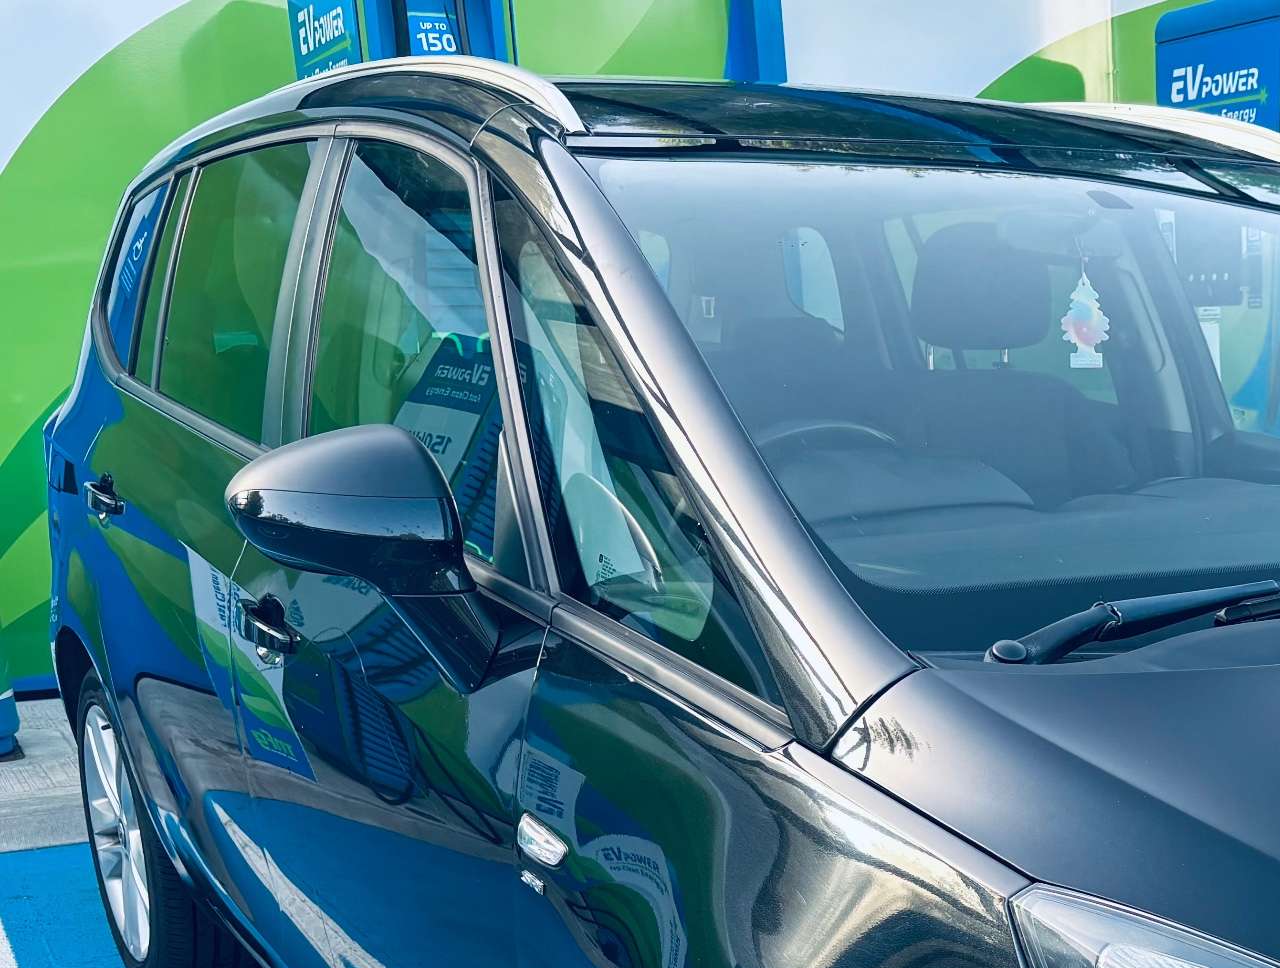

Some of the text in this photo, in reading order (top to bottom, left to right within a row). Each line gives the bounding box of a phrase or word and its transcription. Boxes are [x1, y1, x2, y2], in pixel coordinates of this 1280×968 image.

[420, 22, 446, 31] UP TO
[417, 32, 457, 52] 150
